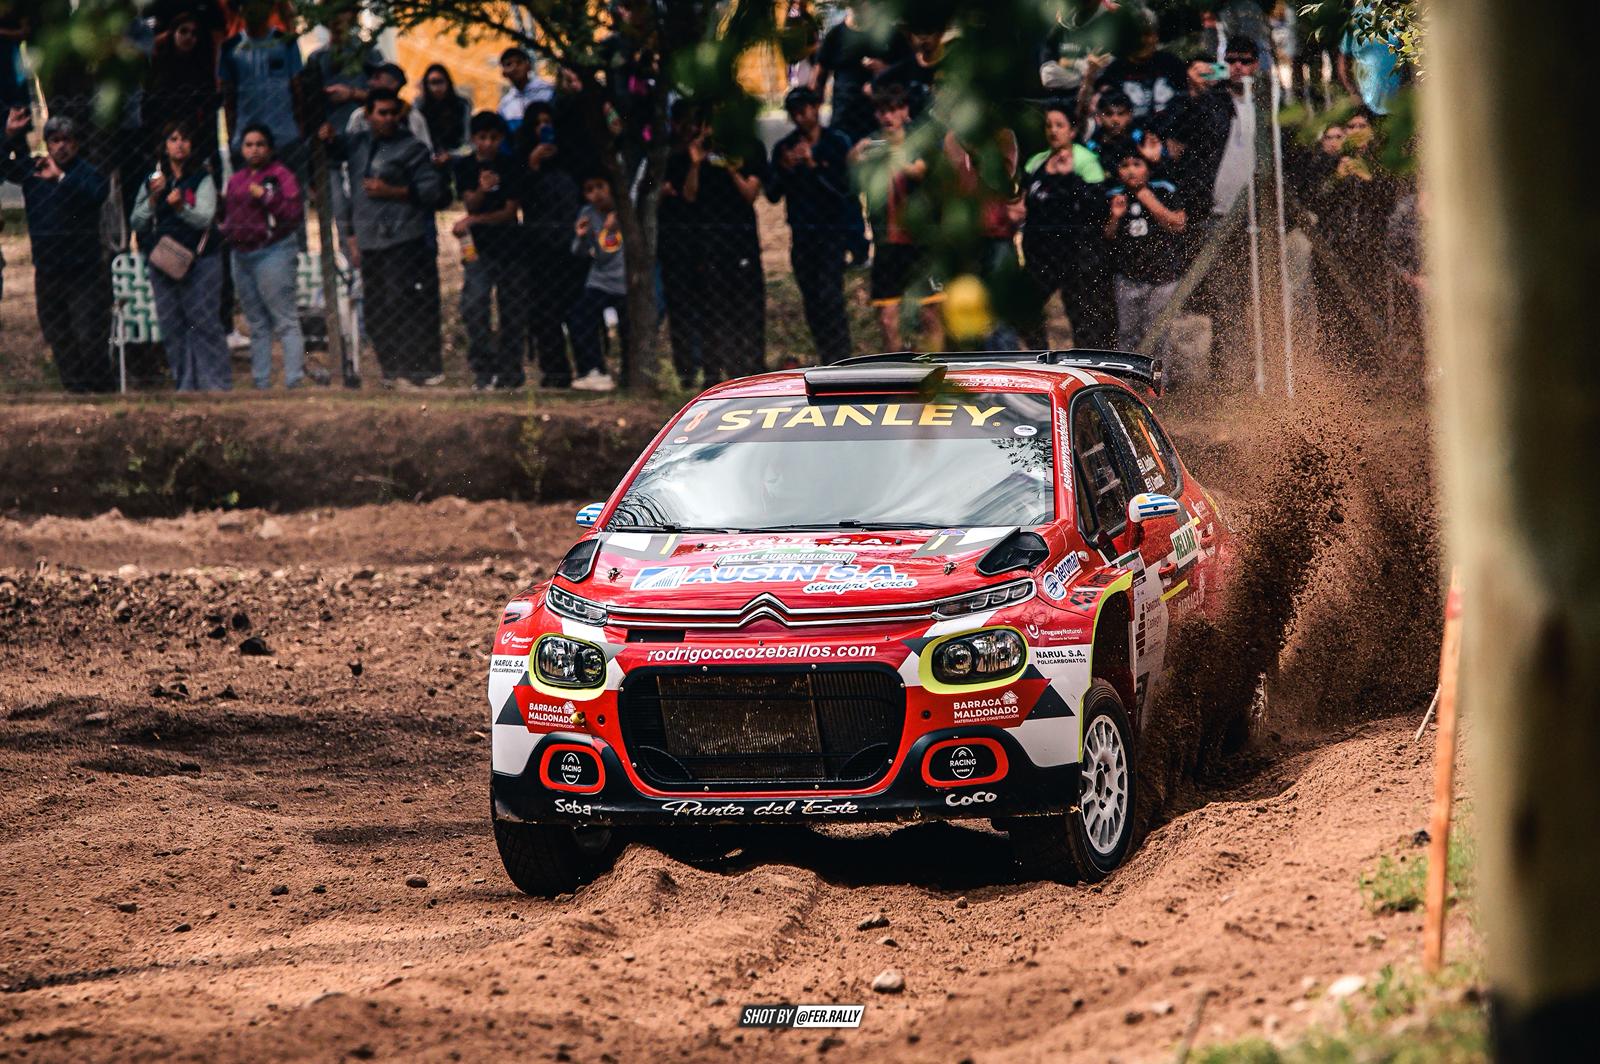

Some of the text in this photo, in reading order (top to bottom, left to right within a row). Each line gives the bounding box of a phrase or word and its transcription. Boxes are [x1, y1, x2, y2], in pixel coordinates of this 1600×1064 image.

[717, 404, 1006, 431] STANLEY
[686, 565, 904, 583] AUSIN S.A.
[806, 579, 914, 593] siempre cerca
[647, 644, 876, 663] rodrigococozeballos.com
[1035, 649, 1086, 659] NARUL S.A.
[493, 659, 513, 667] NARUL
[529, 702, 563, 713] BARRACA
[953, 698, 1002, 710] BARRACA
[953, 705, 1019, 719] MALDONADO
[561, 764, 582, 773] RACING
[949, 758, 977, 767] RACING
[554, 798, 592, 816] Seba
[661, 799, 859, 816] Punta del Este
